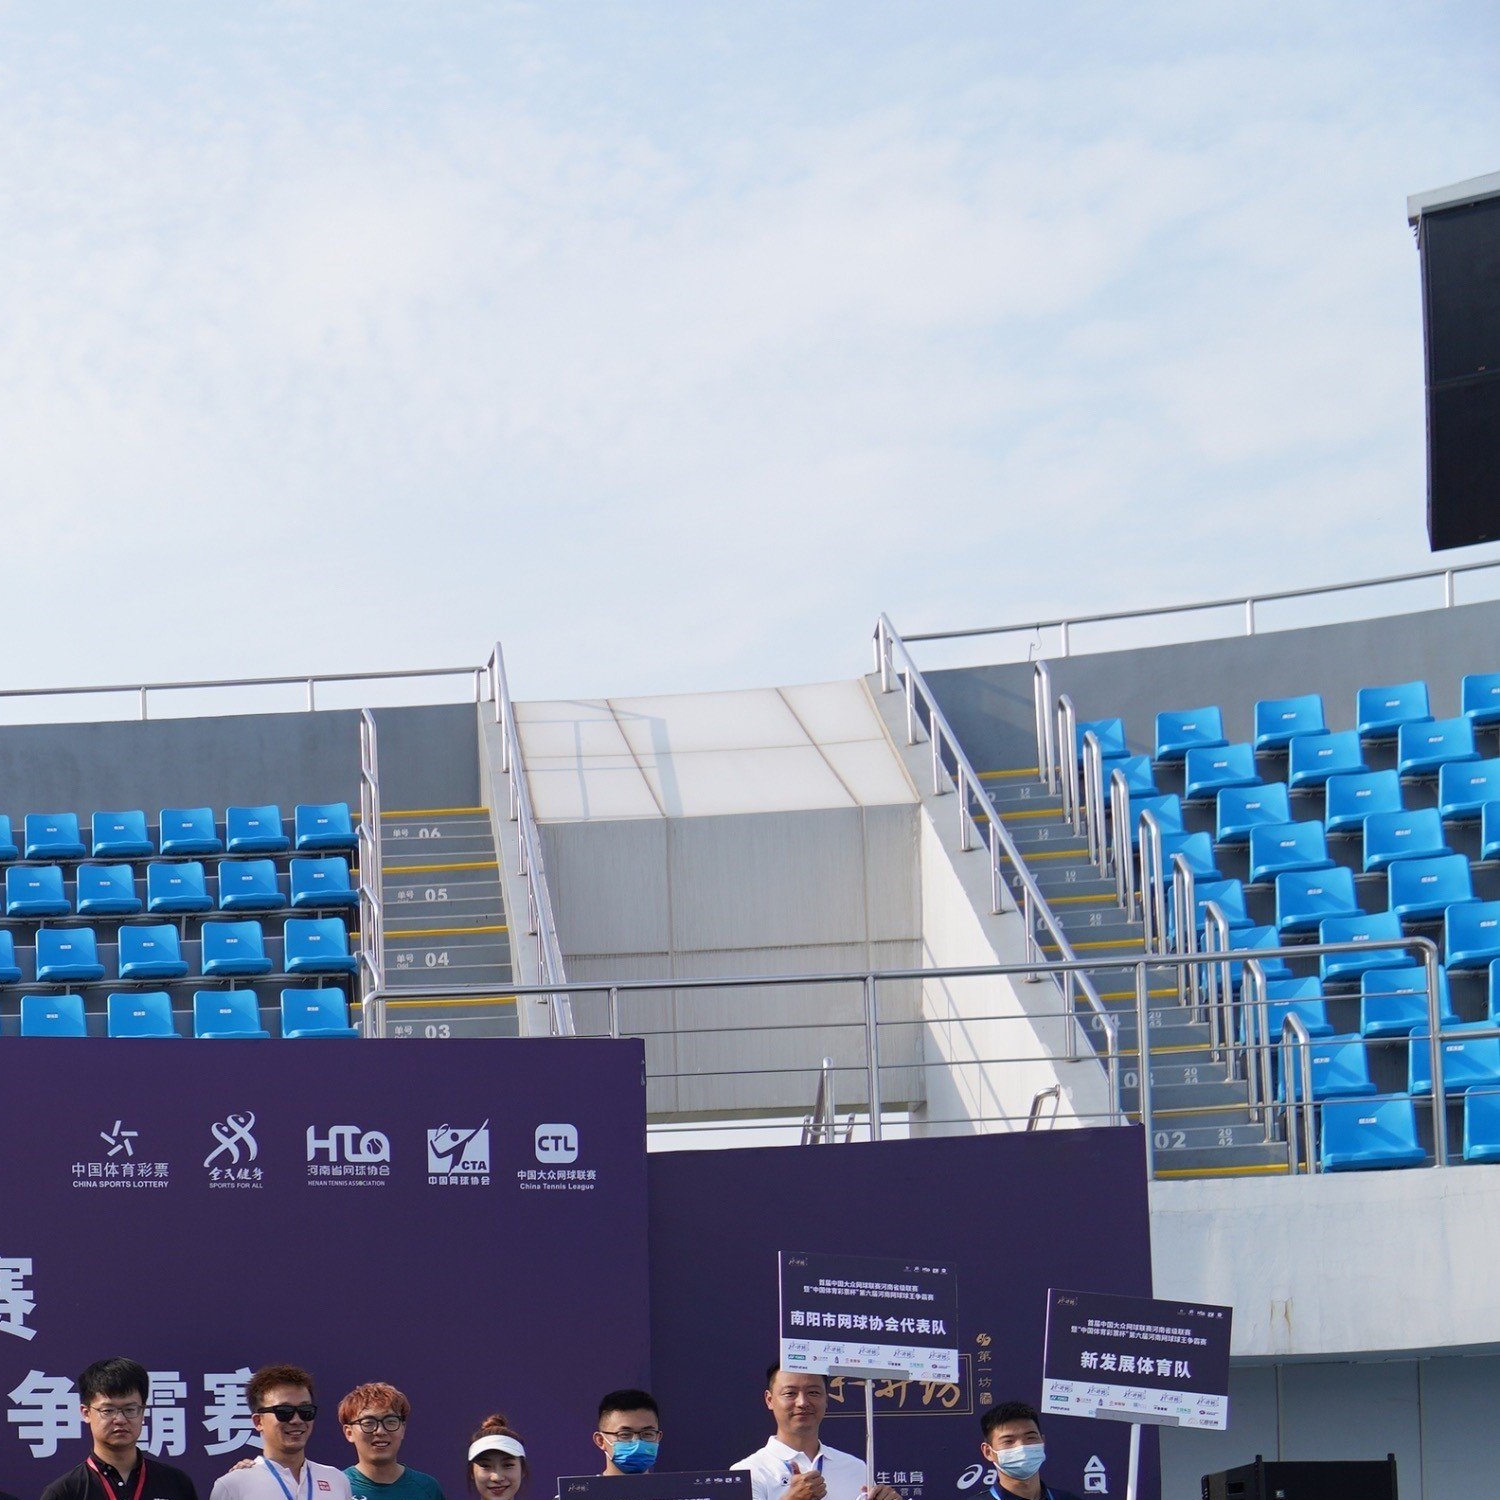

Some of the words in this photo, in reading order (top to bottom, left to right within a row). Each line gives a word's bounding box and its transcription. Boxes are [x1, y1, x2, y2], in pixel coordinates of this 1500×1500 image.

[419, 828, 441, 838] 06
[425, 889, 448, 901] 05
[425, 952, 449, 967] 04
[425, 1025, 450, 1039] 03
[537, 1135, 576, 1152] CTL
[1155, 1131, 1186, 1148] 02
[71, 1162, 170, 1178] 中国体育彩票
[307, 1164, 390, 1176] 河南省网球协会
[461, 1160, 487, 1171] CTA
[209, 1166, 264, 1181] 全民健身
[517, 1169, 597, 1181] 中国大众网球联赛
[72, 1180, 98, 1188] CHINA
[99, 1180, 131, 1188] SPORTS
[133, 1180, 169, 1188] LOTTERY
[428, 1175, 491, 1186] 中国网球协会
[568, 1183, 594, 1191] League
[790, 1310, 947, 1336] 南阳市网球协会代表队
[1080, 1350, 1192, 1379] 新发展体育队
